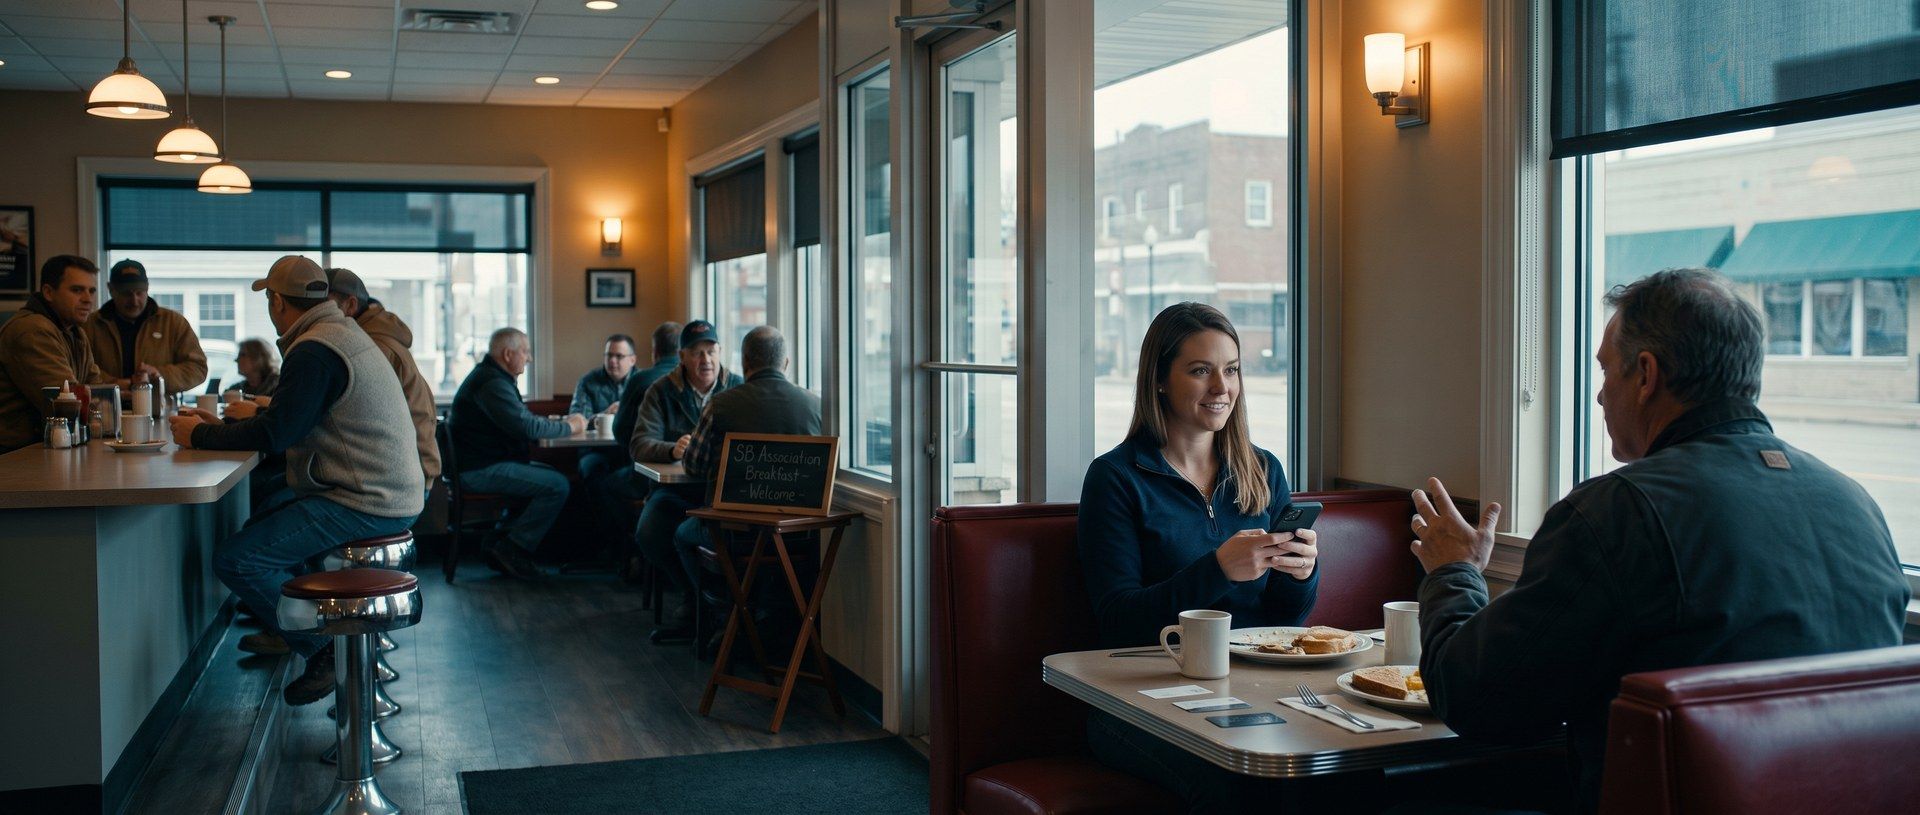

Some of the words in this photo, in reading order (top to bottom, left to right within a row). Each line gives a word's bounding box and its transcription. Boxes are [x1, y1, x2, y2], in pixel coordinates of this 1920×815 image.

[734, 444, 755, 462] SB
[757, 445, 821, 465] Association
[745, 465, 799, 482] Breakfast
[749, 484, 795, 501] Welcome
